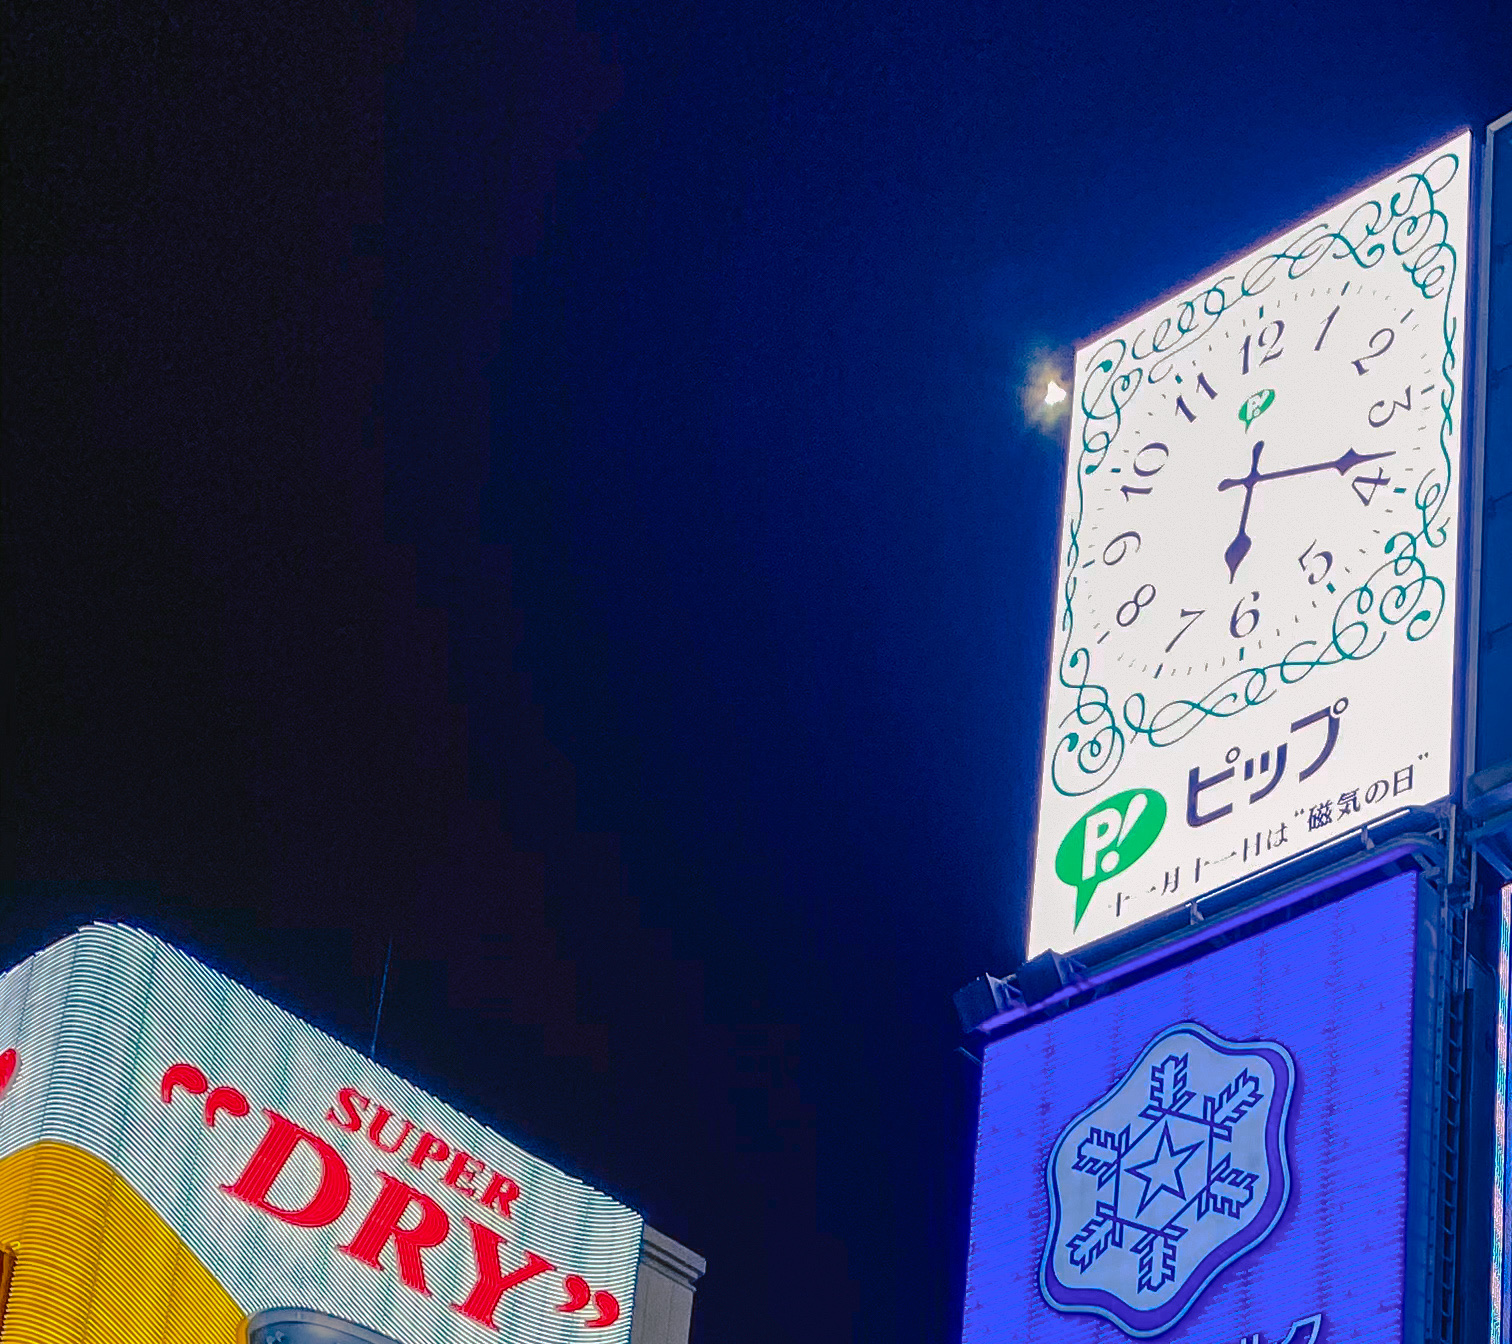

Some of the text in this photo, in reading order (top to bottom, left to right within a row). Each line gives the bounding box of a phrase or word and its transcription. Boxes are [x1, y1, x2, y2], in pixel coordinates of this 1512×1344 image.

[1237, 319, 1284, 376] 12
[1314, 305, 1339, 351] 1
[1353, 328, 1396, 376] 2
[1175, 372, 1219, 424] 11
[1368, 385, 1412, 429] 3
[1120, 442, 1170, 502] 10
[1350, 464, 1391, 506] 4
[1103, 529, 1141, 567] 9
[1298, 541, 1333, 584] 5
[1116, 582, 1156, 627] 8
[1229, 591, 1260, 639] 6
[1167, 609, 1205, 654] 7
[1186, 697, 1349, 828] ピップ
[325, 1086, 521, 1221] SUPER
